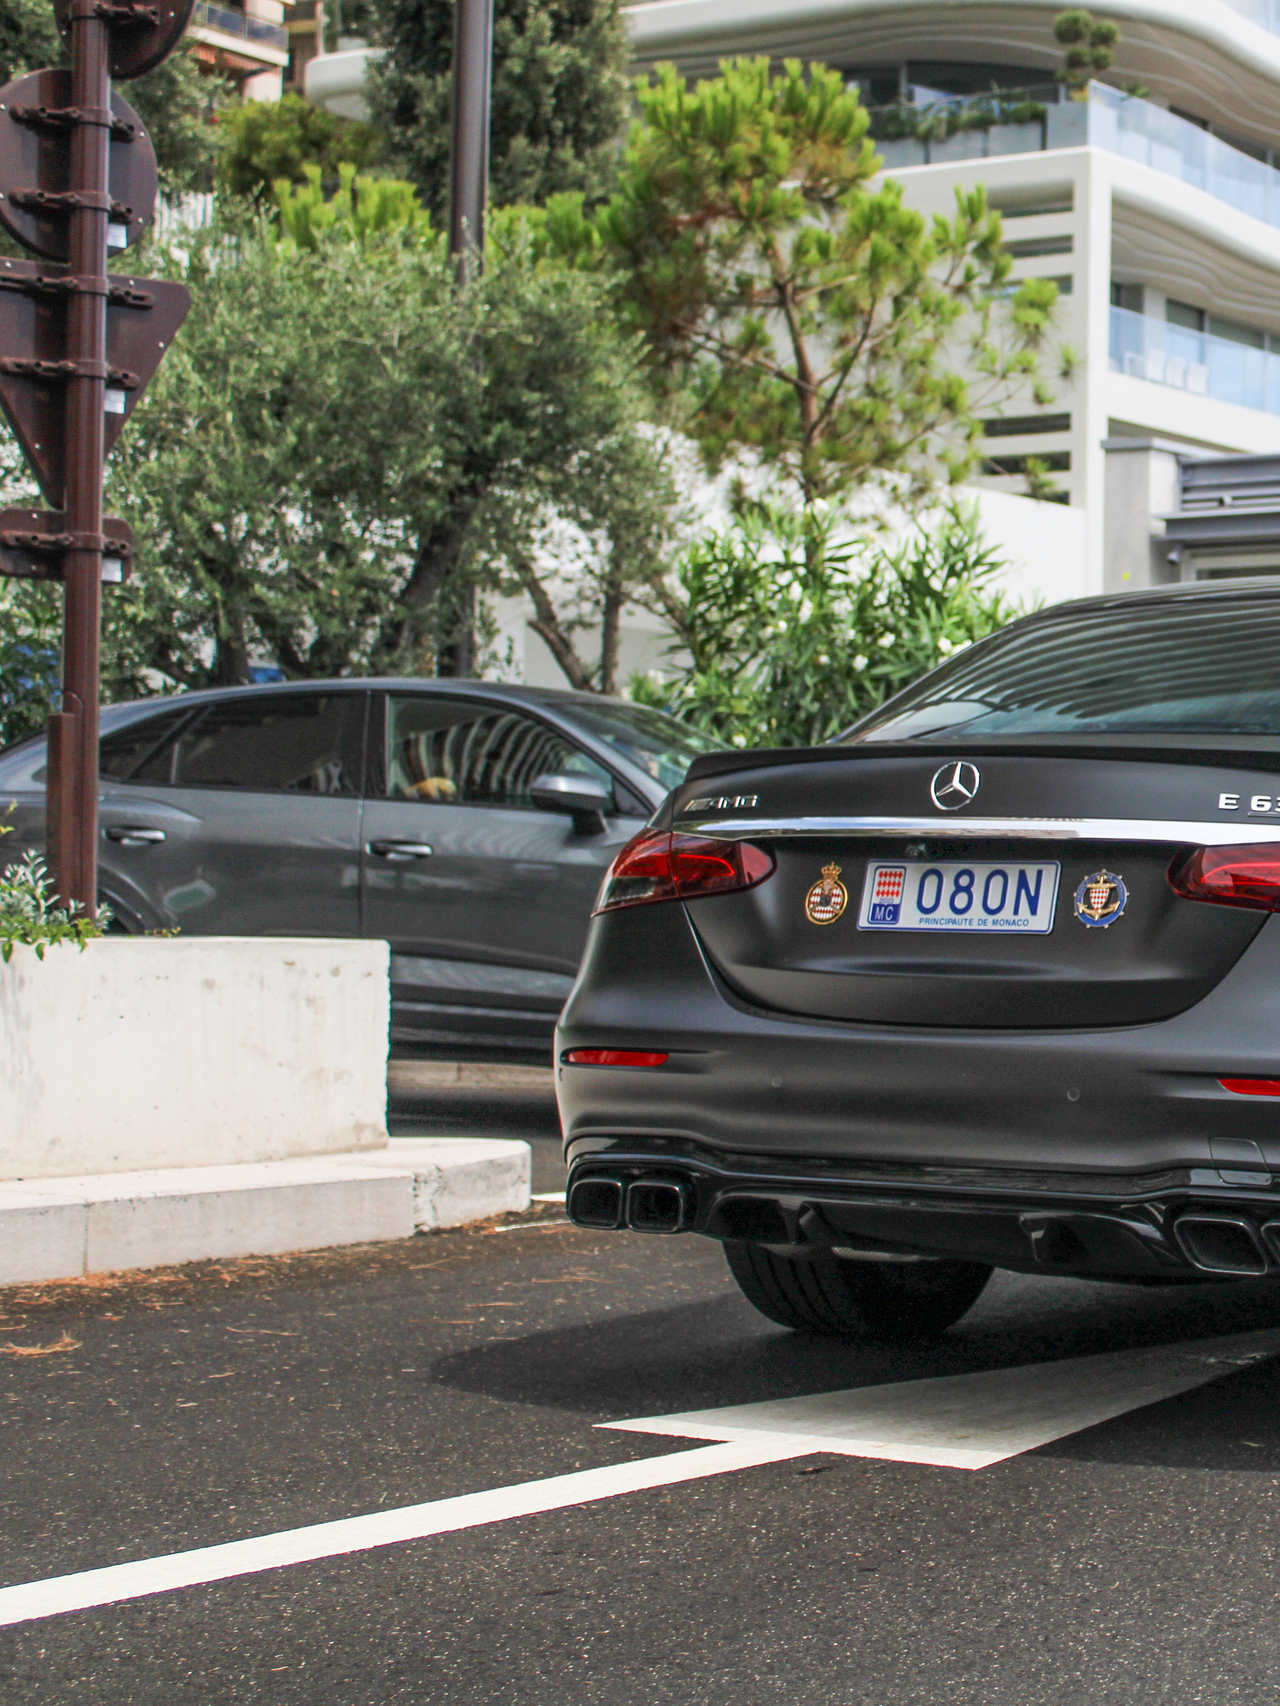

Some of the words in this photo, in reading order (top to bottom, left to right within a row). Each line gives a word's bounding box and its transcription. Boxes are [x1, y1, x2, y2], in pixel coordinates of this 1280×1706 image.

[1218, 793, 1240, 810] E
[874, 906, 894, 921] MC
[919, 917, 974, 926] PRINCIPAUTE
[977, 918, 988, 926] DE
[992, 918, 1029, 927] MONACO
